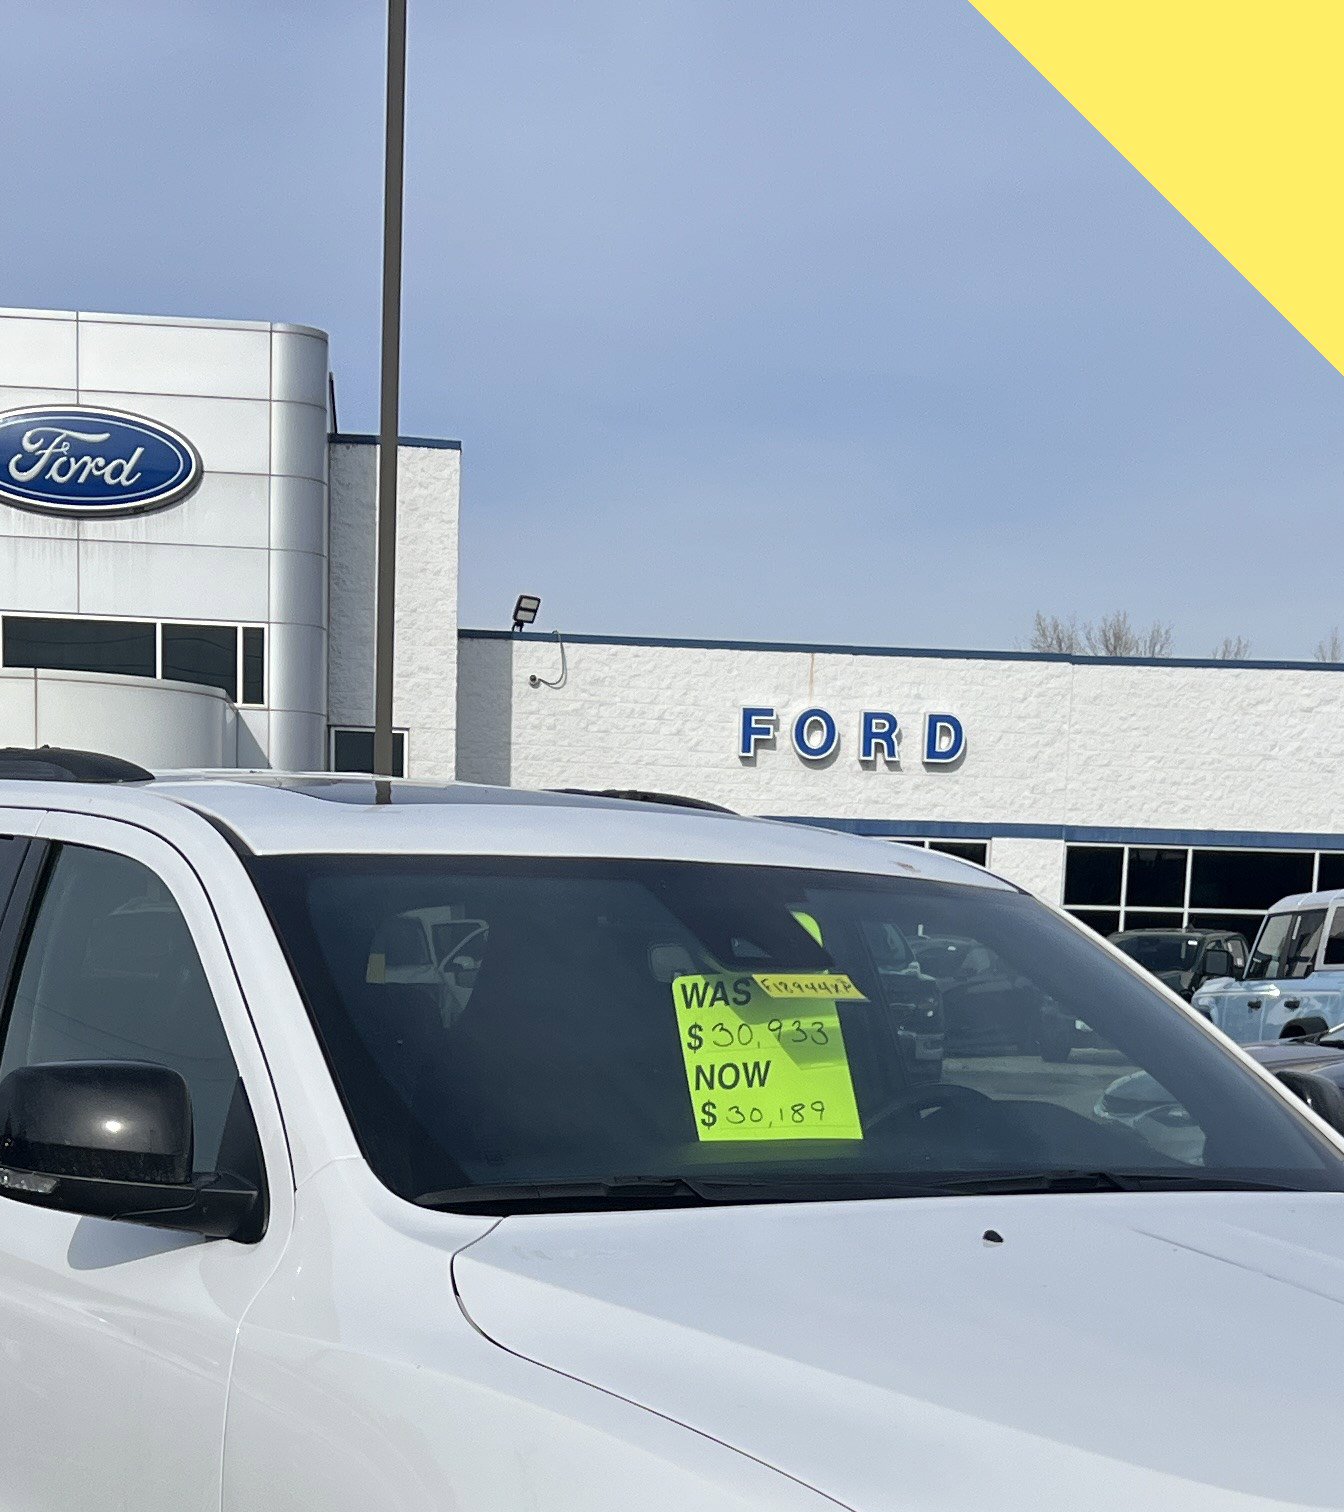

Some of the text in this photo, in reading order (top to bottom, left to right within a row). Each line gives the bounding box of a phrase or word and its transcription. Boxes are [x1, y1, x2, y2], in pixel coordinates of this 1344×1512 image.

[8, 426, 145, 487] Ford
[738, 705, 966, 764] FORD
[680, 977, 752, 1009] WAS
[694, 1060, 772, 1091] NOW
